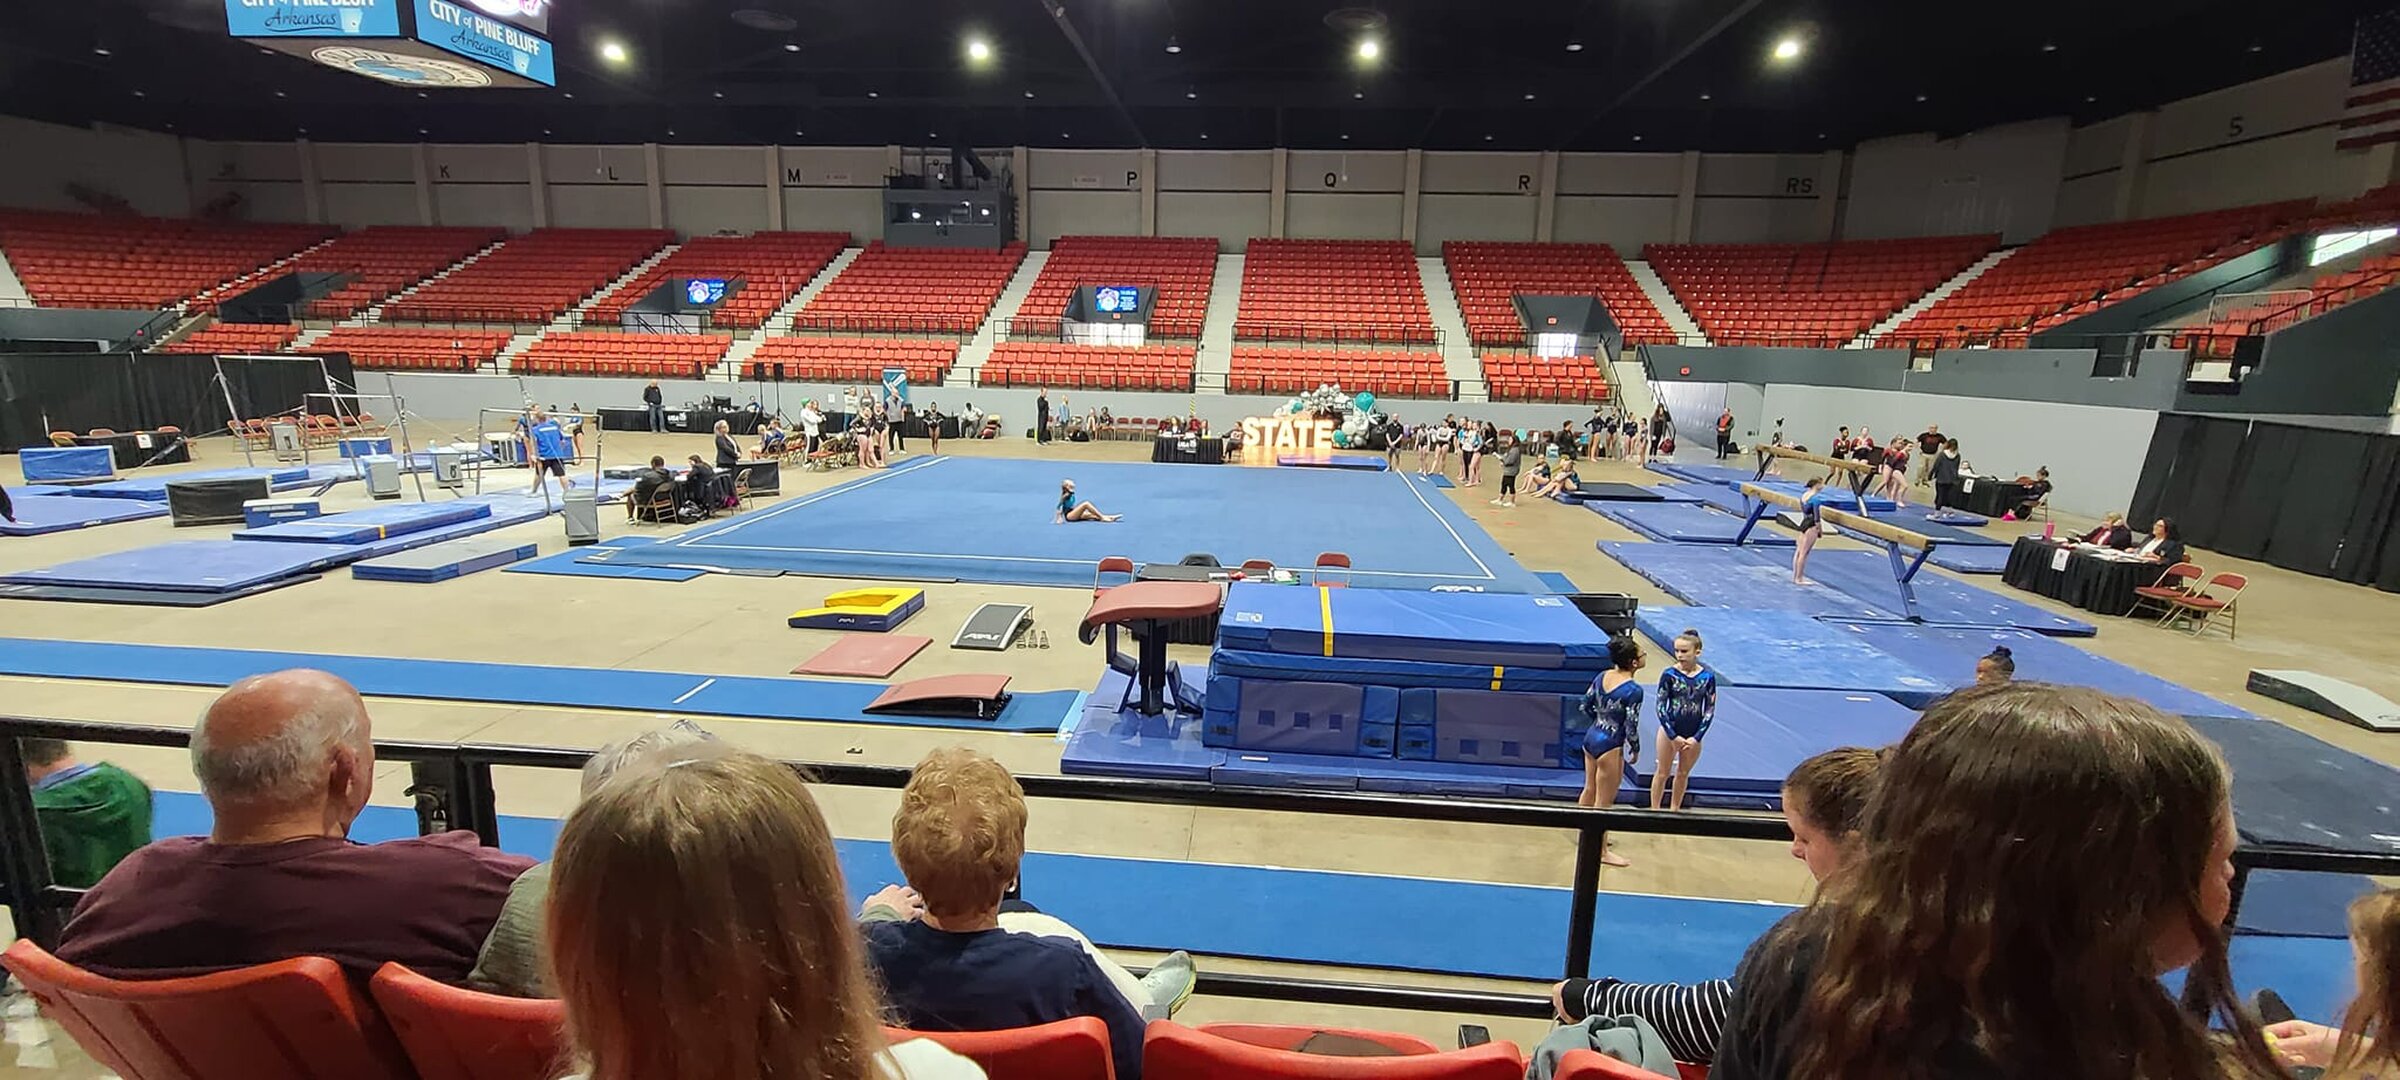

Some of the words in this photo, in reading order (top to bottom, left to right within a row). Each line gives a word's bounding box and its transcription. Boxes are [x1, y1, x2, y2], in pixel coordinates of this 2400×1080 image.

[264, 7, 337, 27] Arkansas
[429, 0, 460, 26] CITY
[463, 16, 473, 28] of
[475, 16, 504, 43] PINE
[505, 26, 540, 56] BLUFF
[450, 30, 510, 61] Arkansas
[2228, 115, 2243, 138] S
[439, 164, 451, 179] K
[608, 166, 619, 181] L
[787, 168, 801, 183] M
[1126, 171, 1138, 187] P
[1324, 172, 1337, 188] Q
[1518, 174, 1531, 190] R
[1785, 177, 1814, 194] RS
[1241, 416, 1335, 450] STATE
